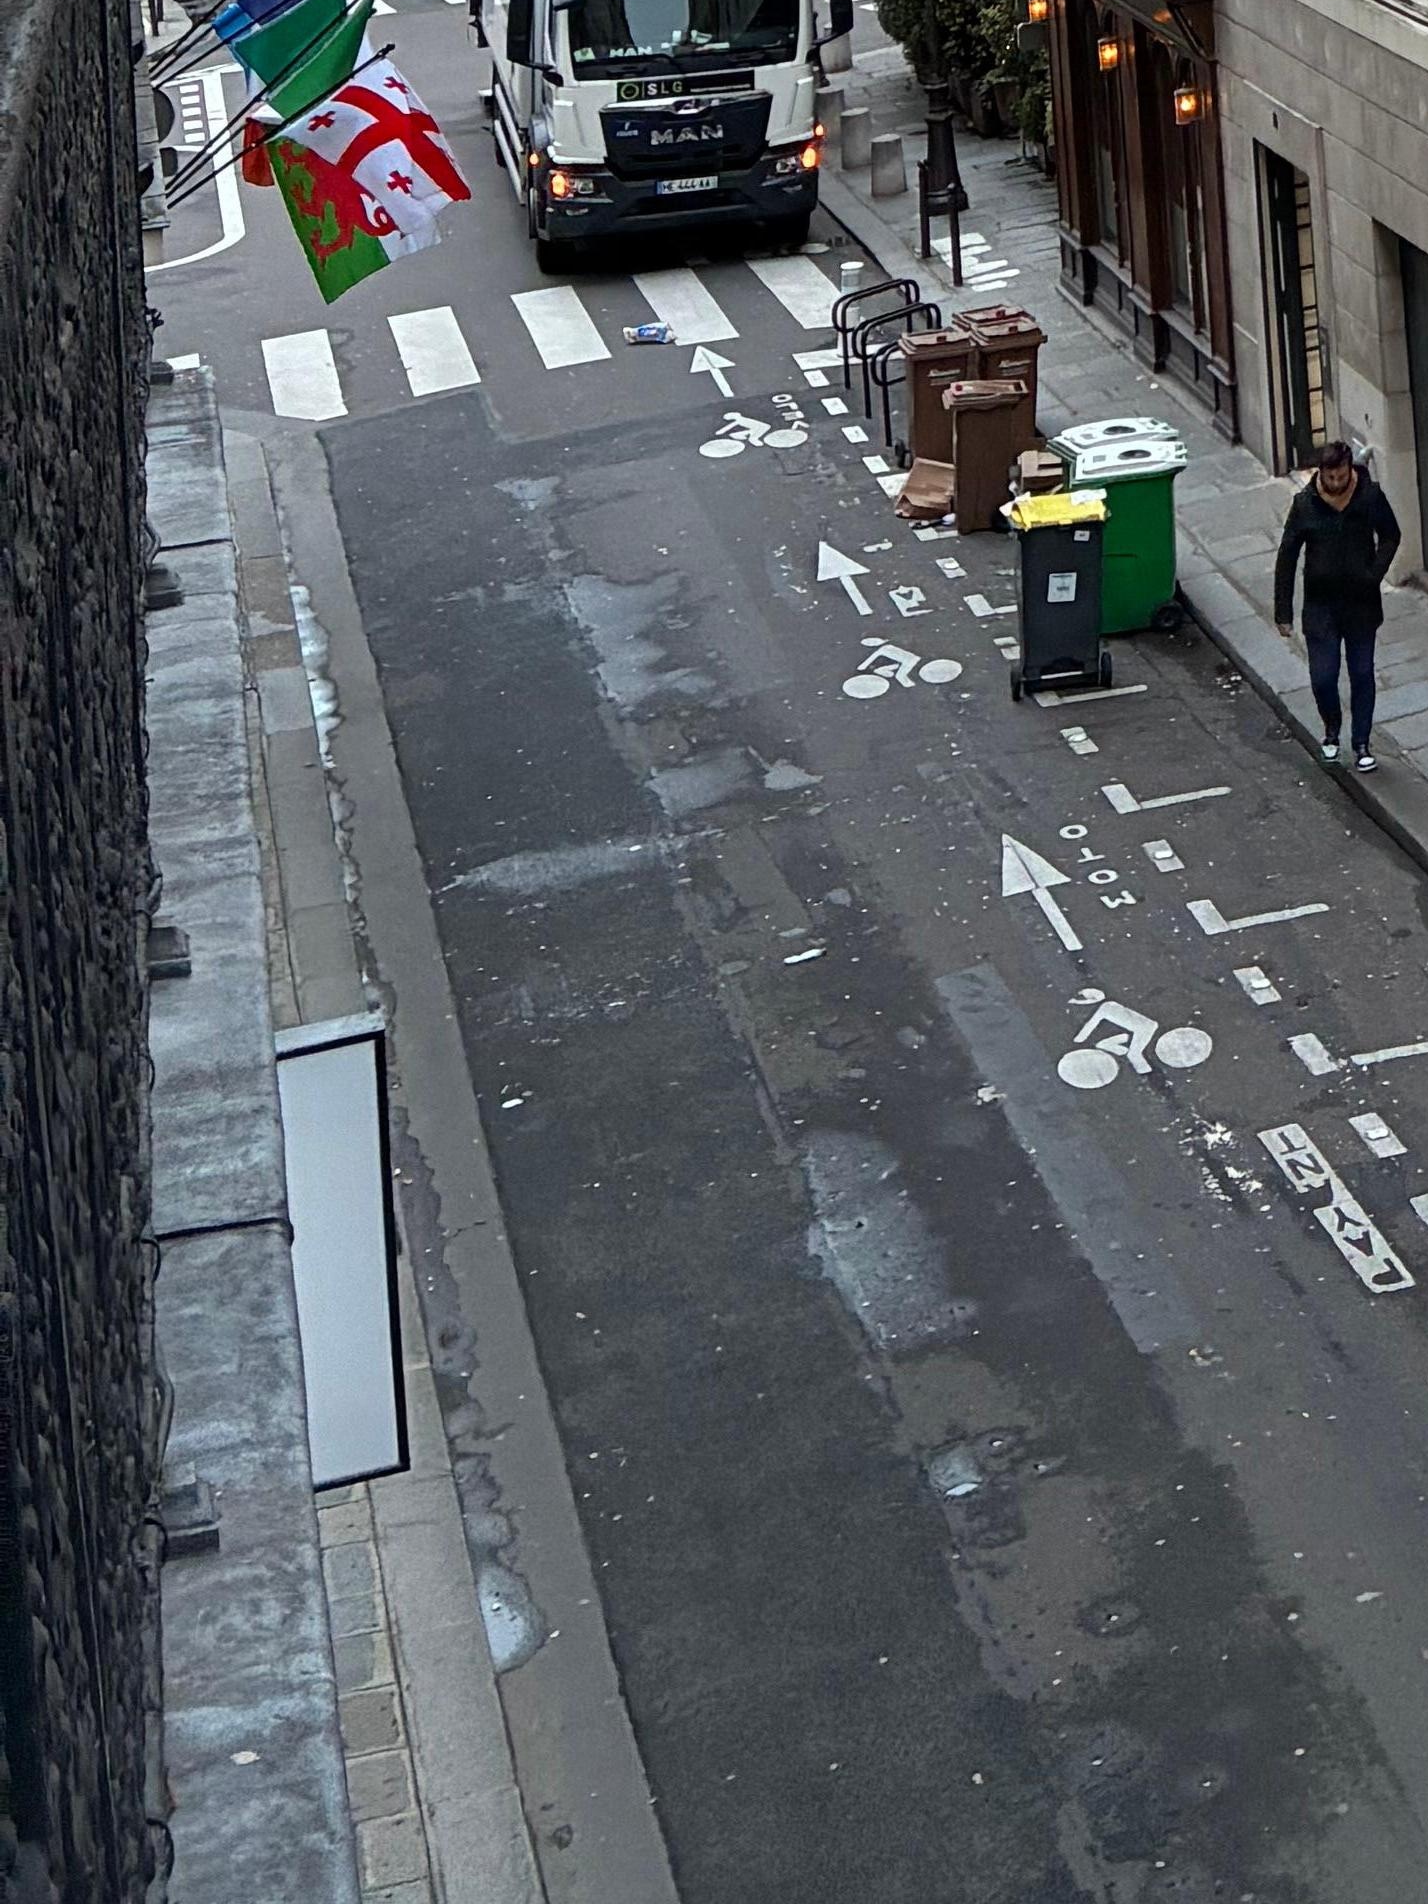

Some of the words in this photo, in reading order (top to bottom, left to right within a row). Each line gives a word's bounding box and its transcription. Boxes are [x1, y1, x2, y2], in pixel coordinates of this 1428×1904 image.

[609, 46, 653, 59] MAN
[650, 124, 724, 146] MAN
[1059, 824, 1137, 909] MOTO
